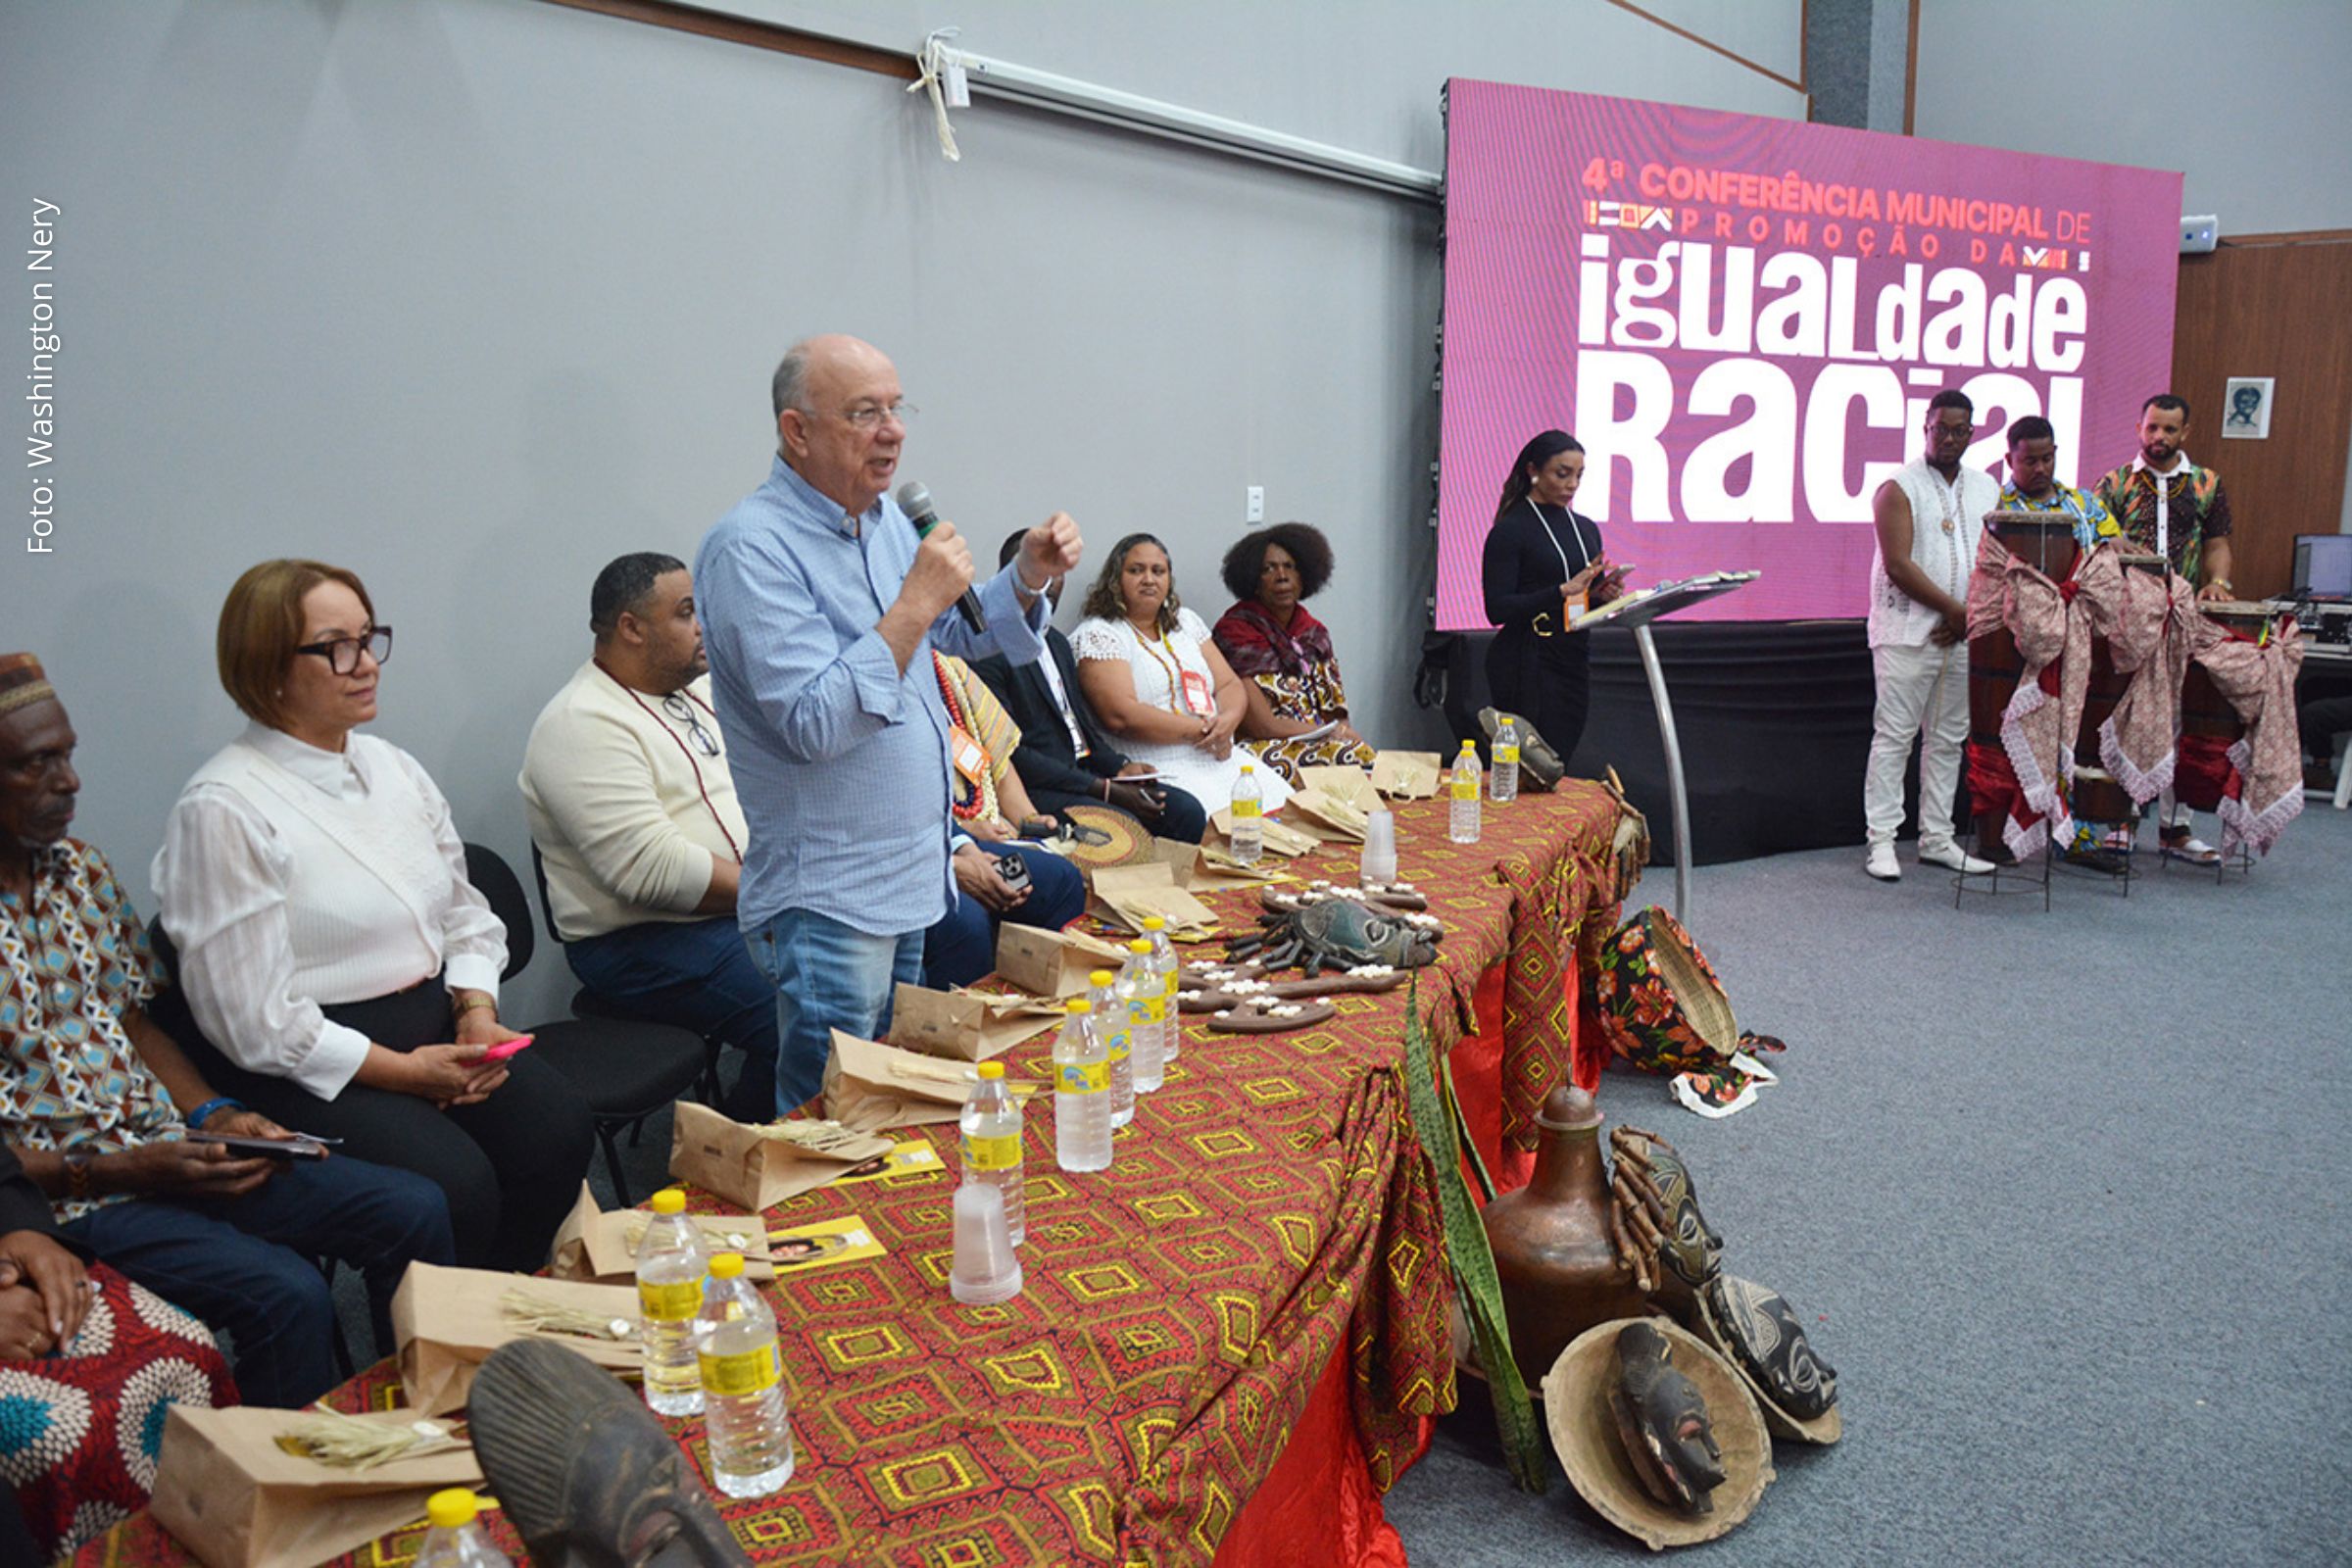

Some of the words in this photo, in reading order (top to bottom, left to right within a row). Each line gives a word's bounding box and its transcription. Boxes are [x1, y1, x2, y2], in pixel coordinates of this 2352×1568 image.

[1640, 163, 1881, 221] CONFERÊNCIA
[1886, 190, 2049, 240] MUNICIPAL
[2057, 210, 2091, 244] DE
[1681, 208, 1940, 259] PROMOÇÃO
[1970, 238, 2016, 267] DA
